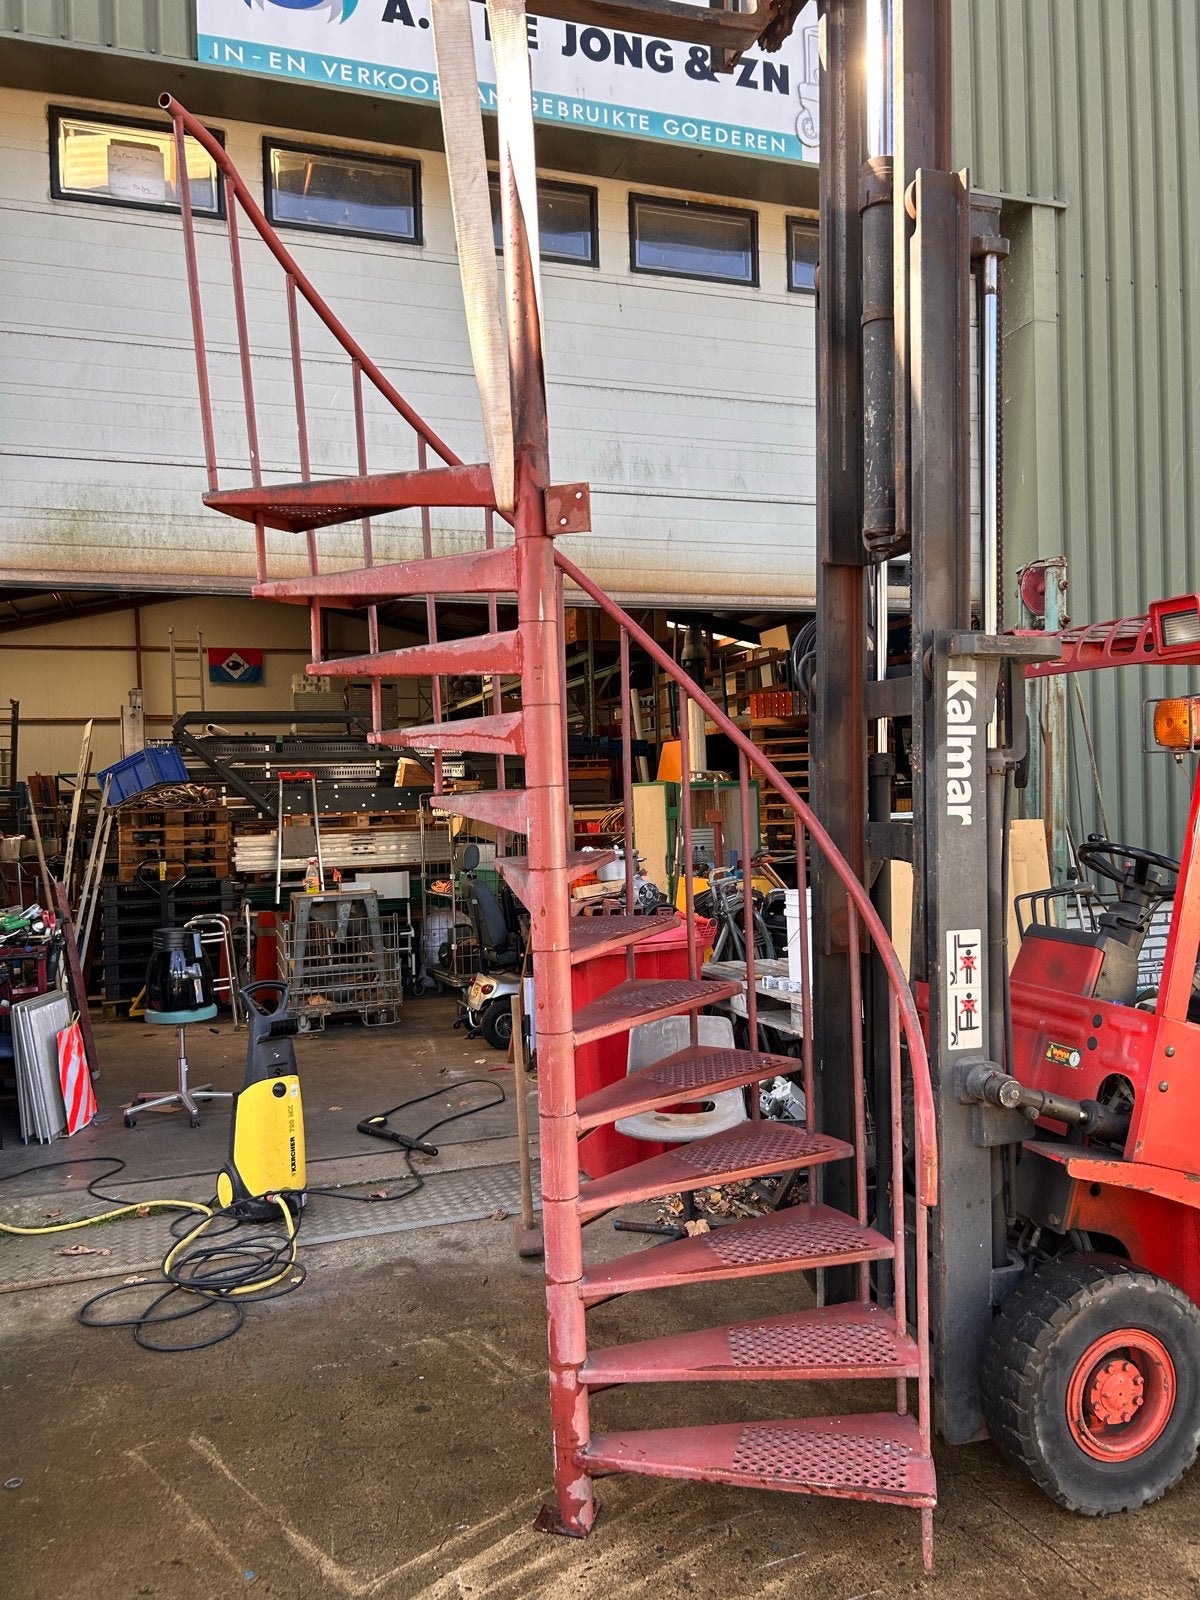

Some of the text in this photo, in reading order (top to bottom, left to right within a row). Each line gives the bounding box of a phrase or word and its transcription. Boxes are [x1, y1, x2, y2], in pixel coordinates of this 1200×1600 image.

[381, 0, 430, 30] A.
[562, 23, 674, 74] JONG
[685, 45, 720, 83] &
[736, 56, 790, 95] ZN
[663, 119, 786, 152] GOEDEREN
[946, 671, 977, 826] Kalmar
